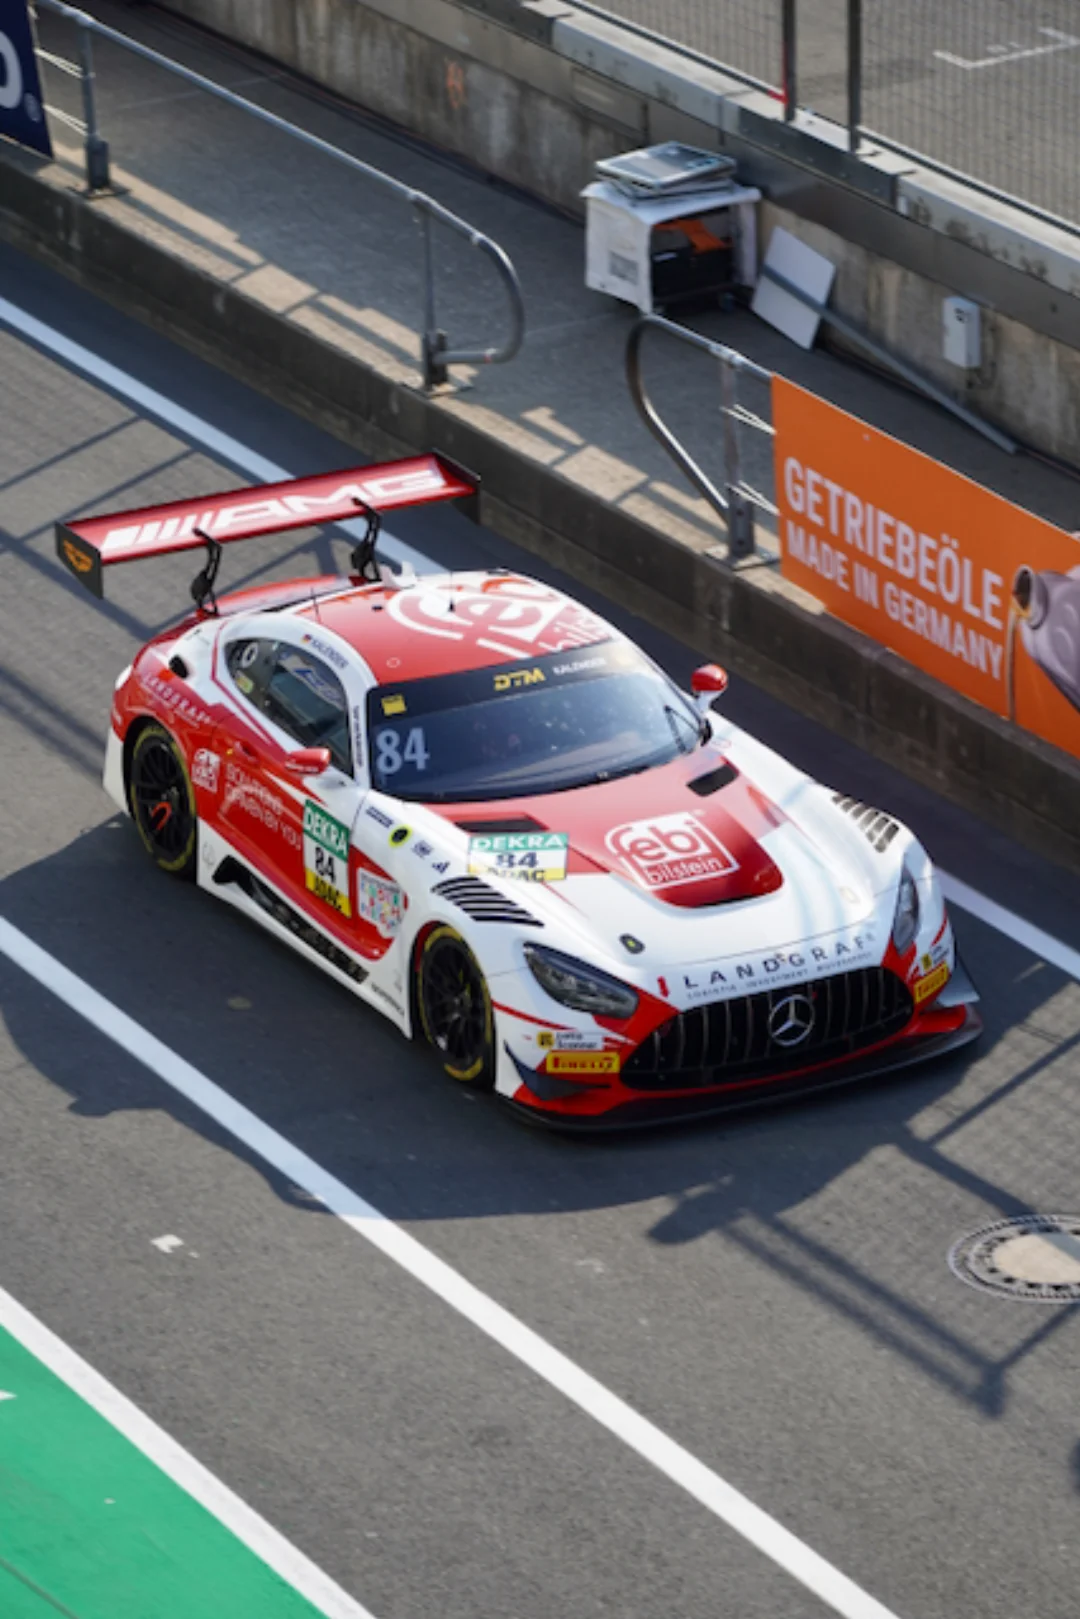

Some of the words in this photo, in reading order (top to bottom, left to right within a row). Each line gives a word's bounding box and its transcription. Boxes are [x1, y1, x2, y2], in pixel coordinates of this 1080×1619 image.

[785, 457, 1003, 630] GETRIEBEÖLE
[786, 520, 850, 592] MADE
[853, 562, 880, 609] IN
[883, 582, 1003, 680] GERMANY
[493, 667, 546, 690] DTM
[376, 727, 431, 775] 84
[303, 805, 349, 860] DEKRA
[472, 834, 564, 851] DEKRA
[644, 857, 723, 884] bilstein
[683, 936, 866, 990] LANDGRAF
